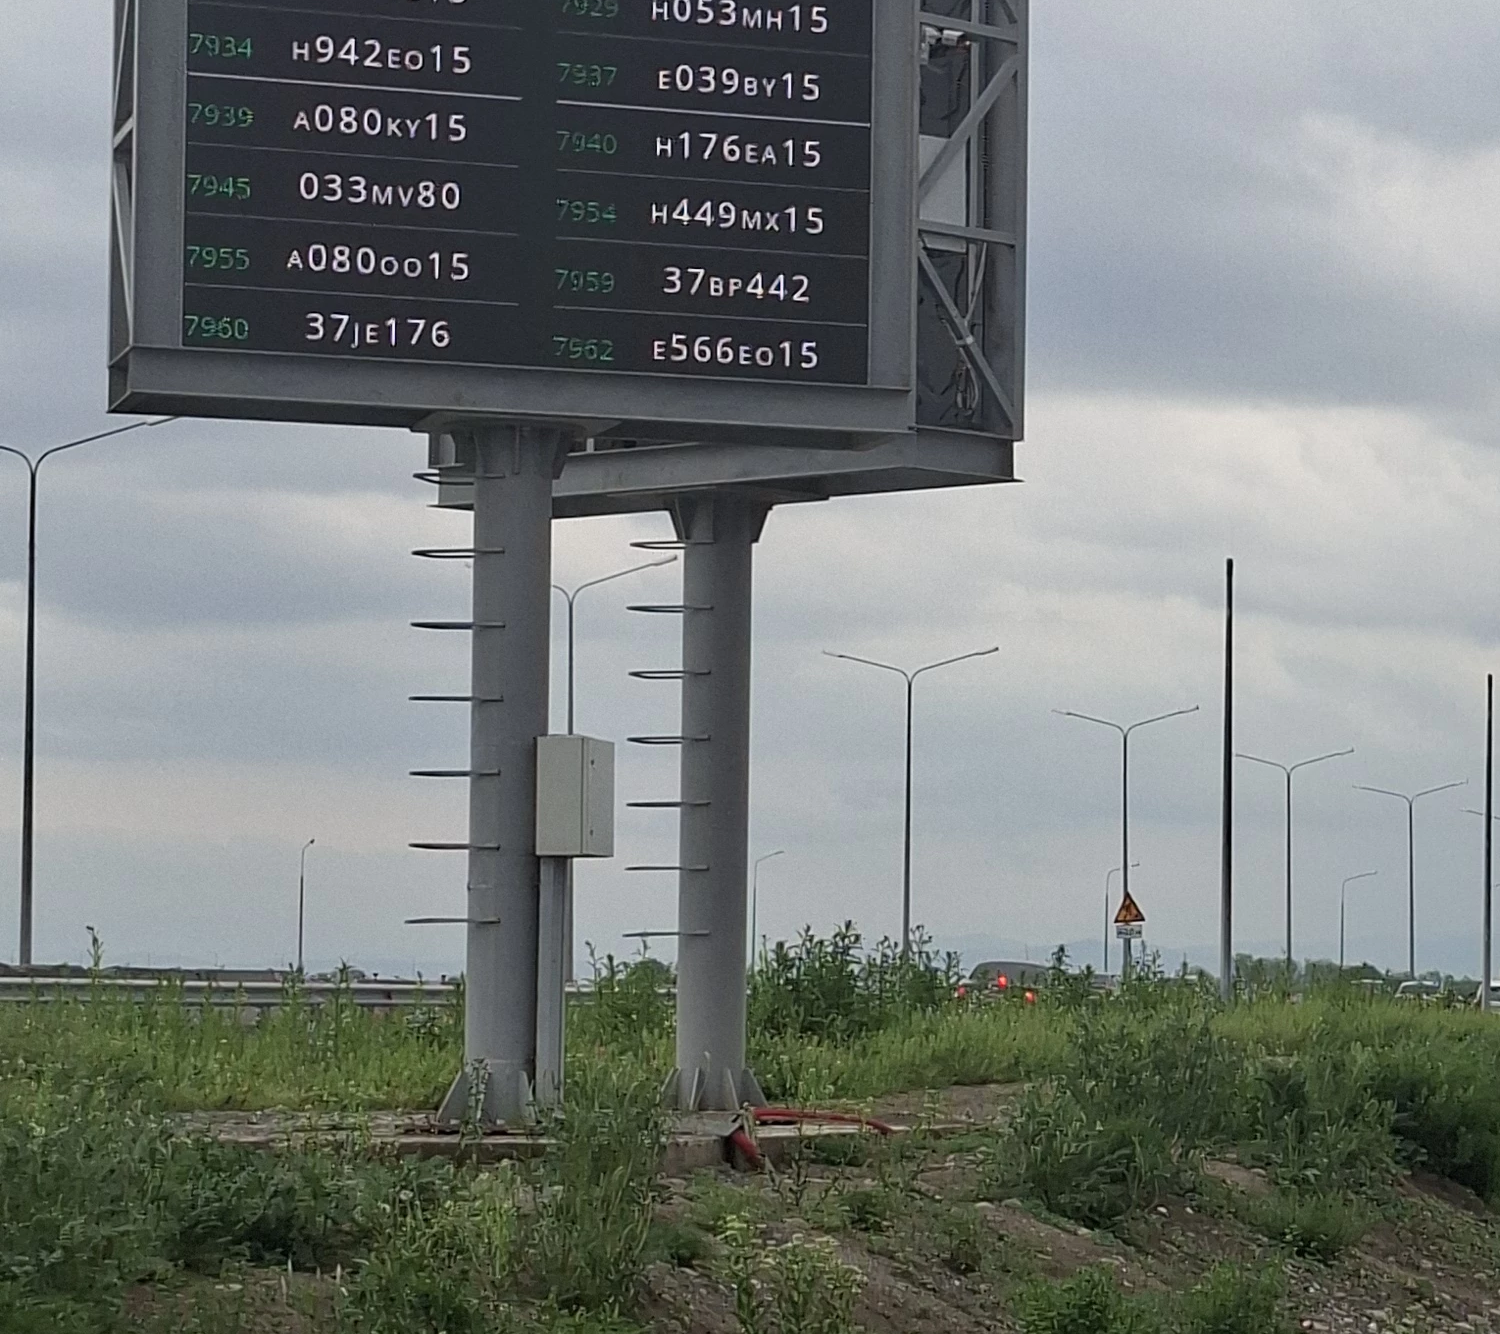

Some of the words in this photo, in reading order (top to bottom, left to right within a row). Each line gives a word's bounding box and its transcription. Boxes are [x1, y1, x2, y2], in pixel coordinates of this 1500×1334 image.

[188, 33, 253, 61] 7934
[292, 35, 471, 74] H942EO15
[658, 64, 820, 101] E039BY15
[188, 103, 255, 131] 7939
[293, 104, 466, 142] A080KY15
[556, 130, 618, 155] 7940
[656, 131, 821, 167] H176EA15
[187, 175, 252, 201] 7945
[299, 172, 460, 210] 033MV80
[651, 198, 823, 234] H449MX15
[186, 245, 250, 270] 7955
[554, 268, 615, 294] 7959
[663, 266, 809, 302] 37BP442
[306, 312, 450, 349] 37JE176
[653, 333, 818, 369] E566EO15
